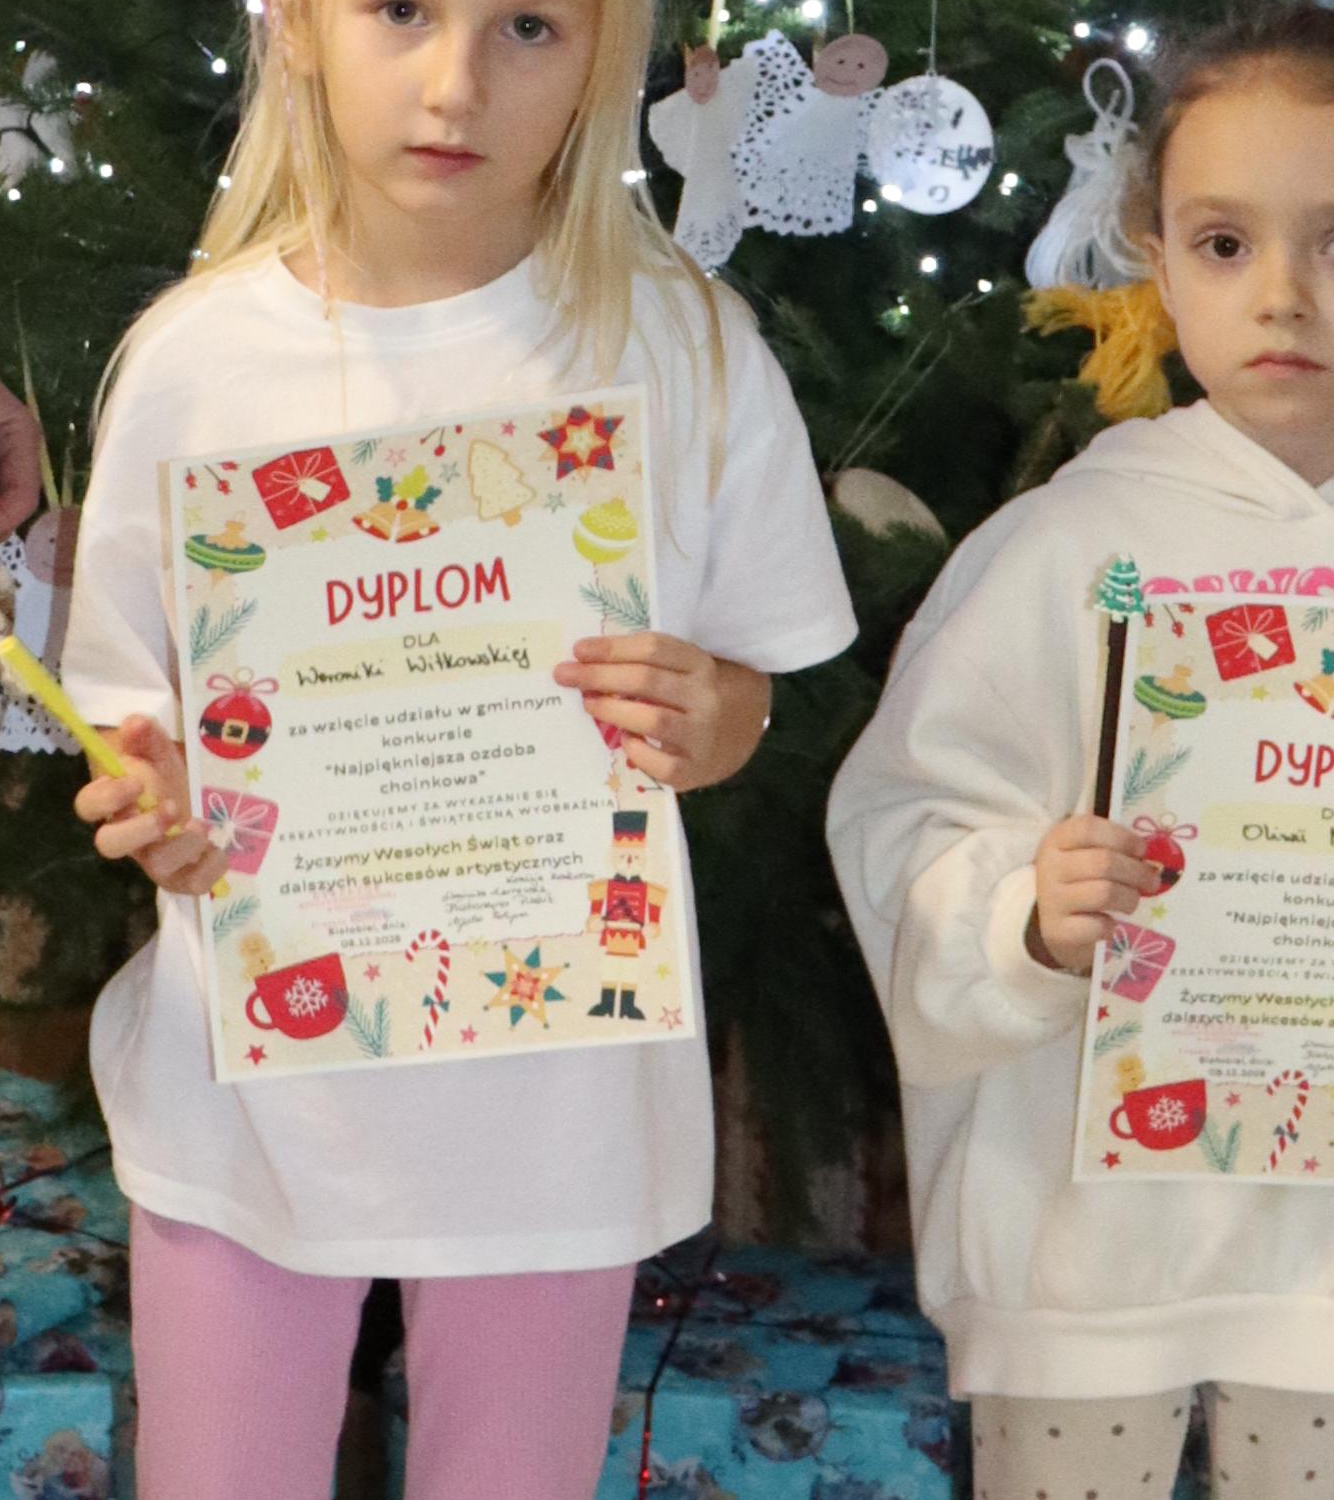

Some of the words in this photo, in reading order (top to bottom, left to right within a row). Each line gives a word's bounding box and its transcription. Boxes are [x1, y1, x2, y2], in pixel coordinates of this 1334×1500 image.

[327, 557, 510, 625] DYPLOM
[403, 632, 440, 649] DLA
[288, 725, 308, 738] za
[313, 716, 380, 733] wzięcie
[385, 706, 452, 725] udziału
[457, 706, 471, 716] w
[476, 694, 562, 717] gminnym
[382, 727, 472, 748] konkursie
[470, 744, 536, 761] ozdoba
[294, 853, 371, 872] Życzymy
[374, 841, 462, 861] Wesołych
[467, 835, 520, 852] Świąt
[525, 832, 565, 847] oraz
[280, 875, 358, 896] dalszych
[363, 867, 451, 886] sukcesów
[456, 852, 584, 876] artystycznych
[1199, 872, 1217, 883] za
[1222, 870, 1285, 886] wzięcie
[1180, 988, 1253, 1006] Życzymy
[1162, 1012, 1235, 1026] dalszych
[1240, 1013, 1325, 1027] sukcesów
